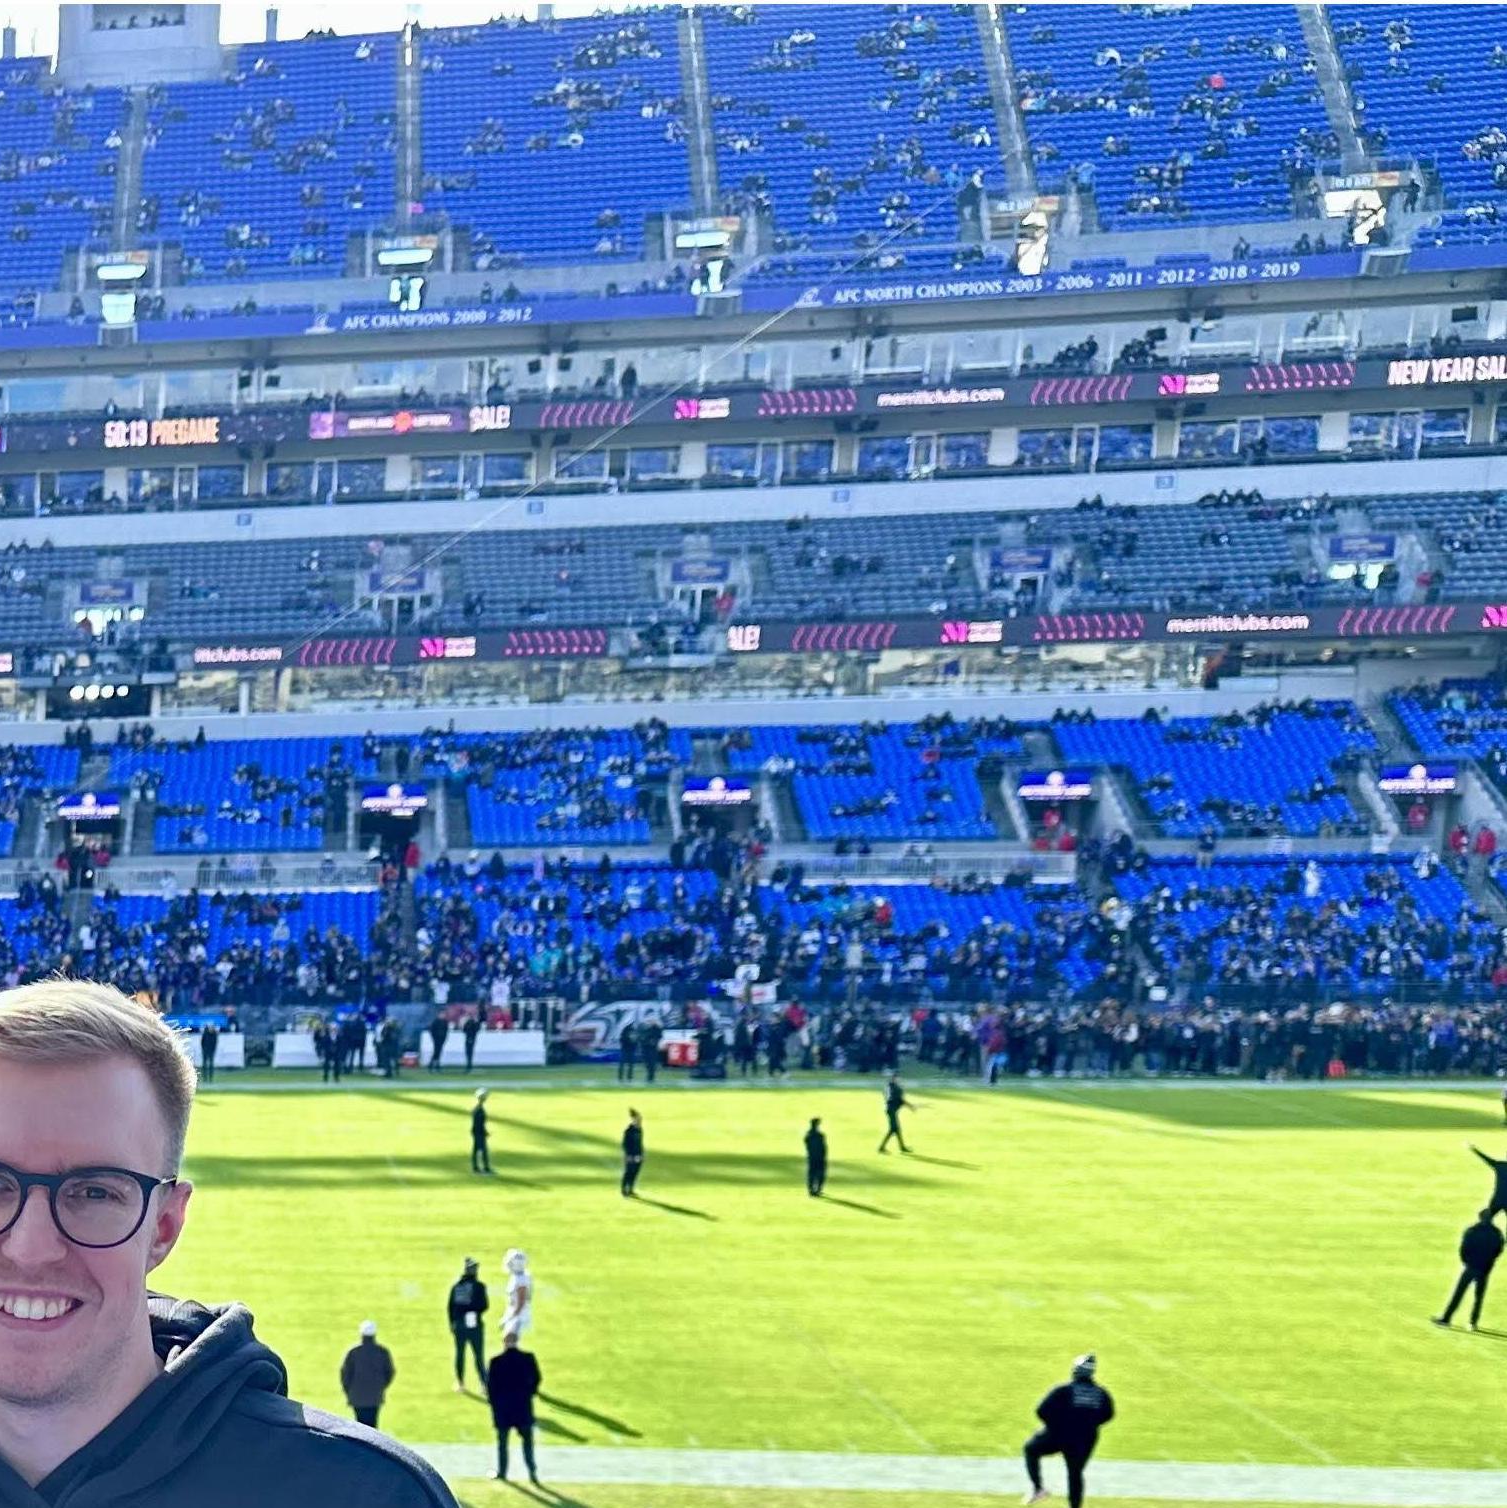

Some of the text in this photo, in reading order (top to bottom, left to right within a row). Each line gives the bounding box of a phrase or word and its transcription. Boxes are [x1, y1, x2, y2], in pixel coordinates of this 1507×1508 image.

[864, 286, 913, 301] NORTH
[916, 280, 1003, 298] CHAMPIONS
[1056, 275, 1093, 291] 2006
[1106, 271, 1142, 288] 2011
[1157, 268, 1196, 284] 2012
[1209, 265, 1248, 281] 2018
[1260, 262, 1300, 278] 2019
[371, 311, 450, 329] CHAMPIONS
[1387, 358, 1429, 385] NEW
[1431, 357, 1476, 384] YEAR
[150, 417, 220, 446] PREGAME
[1166, 612, 1310, 634] merrittclubs.com
